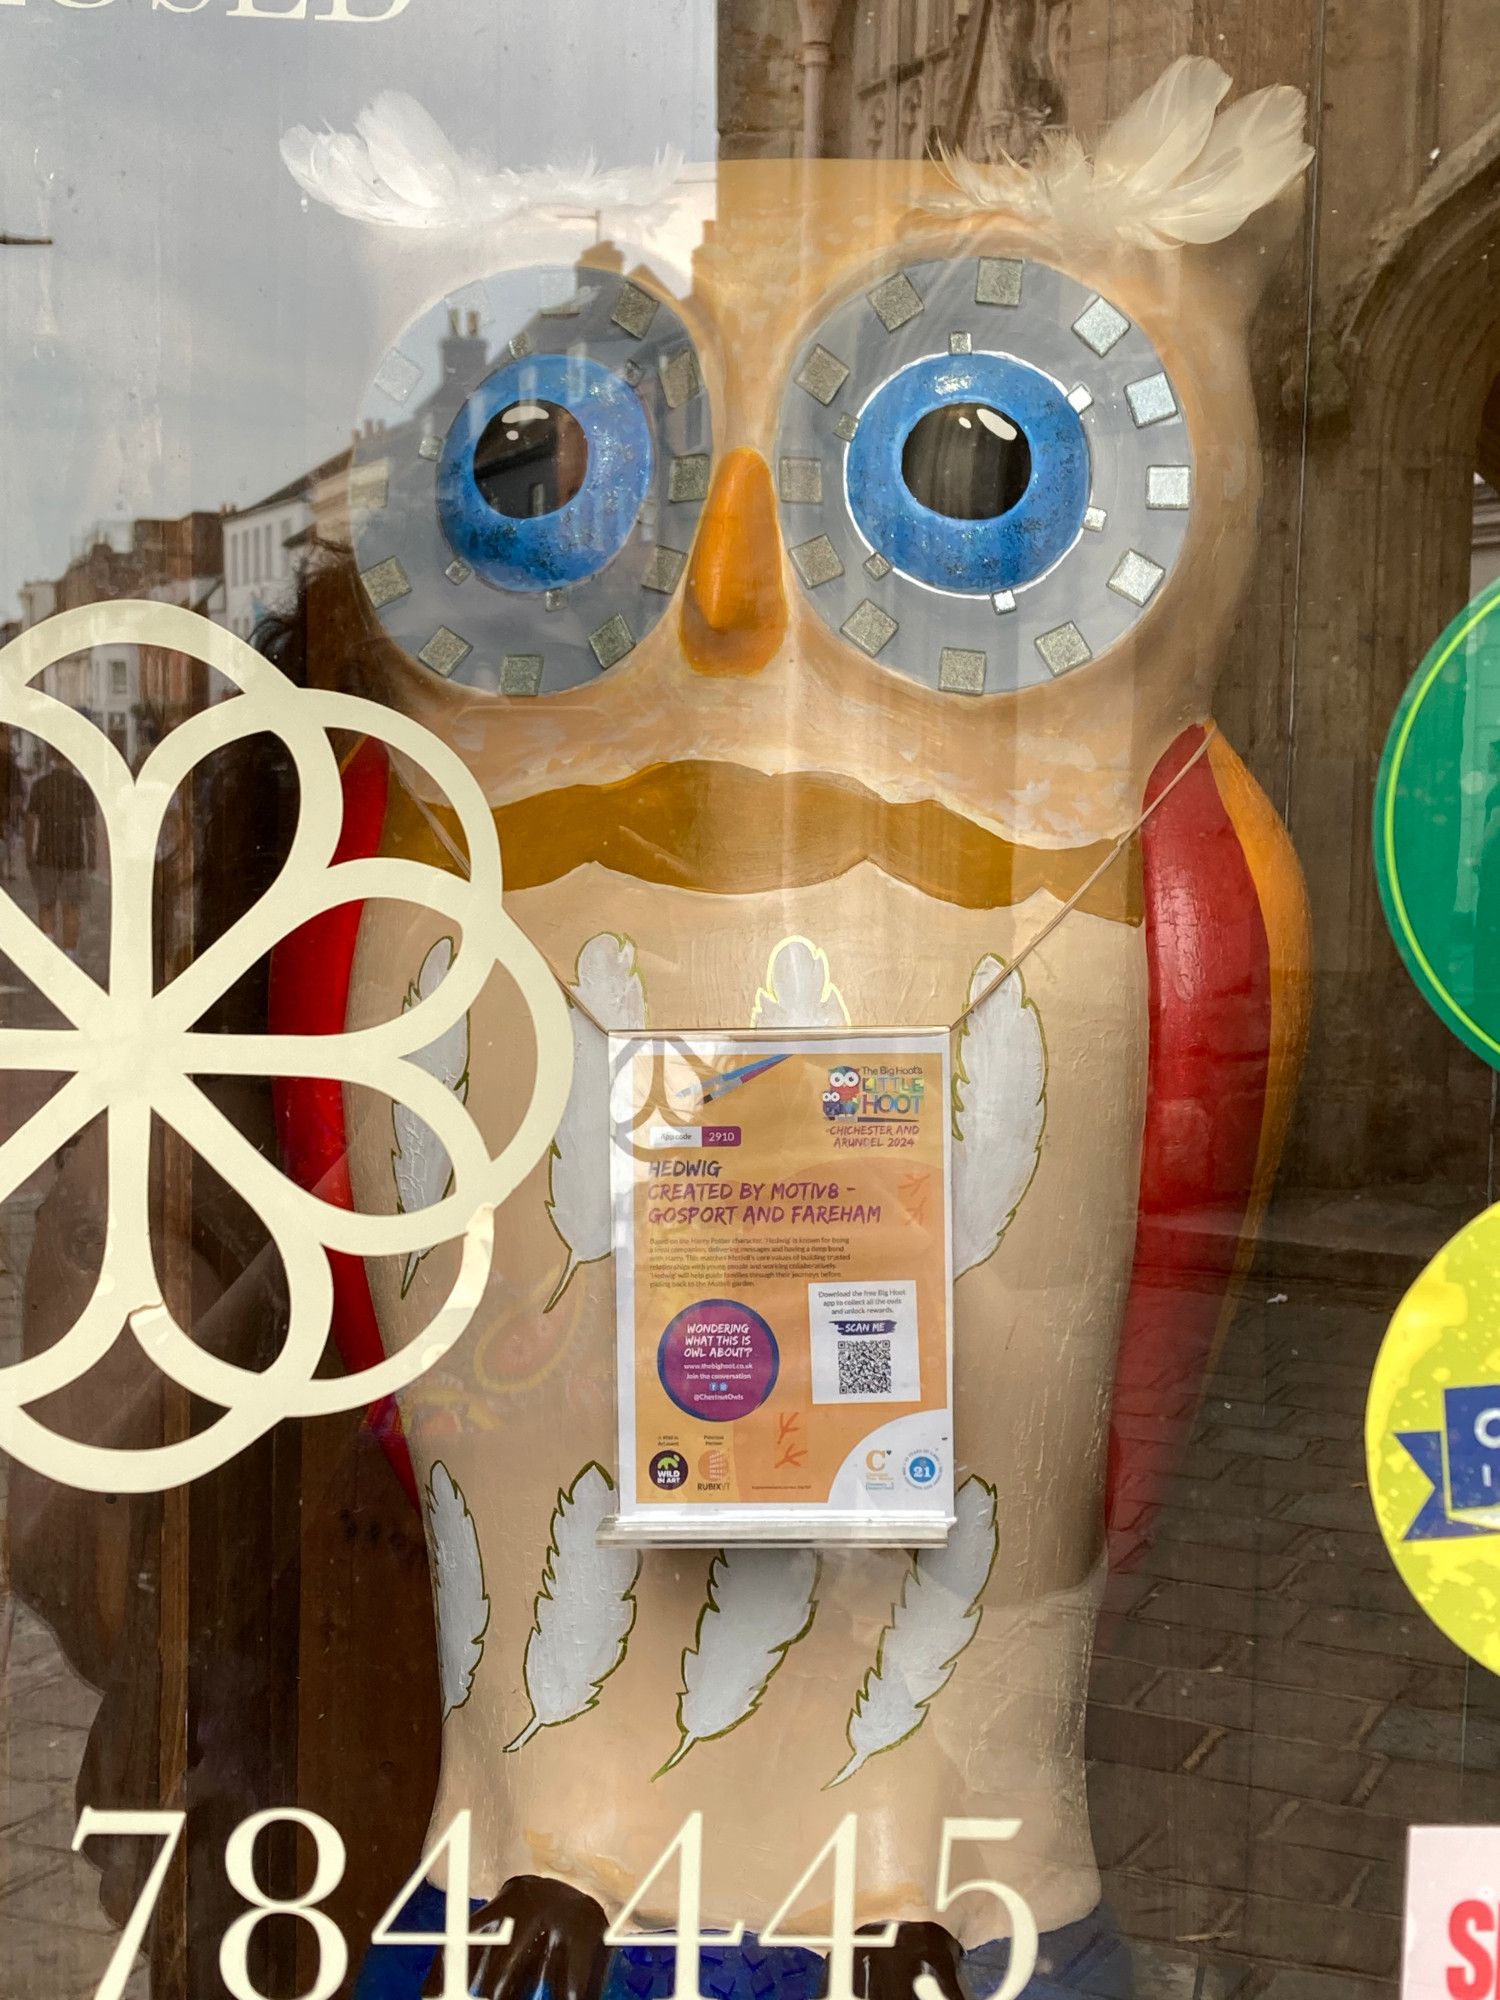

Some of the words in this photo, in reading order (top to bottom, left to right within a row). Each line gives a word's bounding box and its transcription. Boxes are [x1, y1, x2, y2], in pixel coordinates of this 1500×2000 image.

[862, 1065, 879, 1076] The
[880, 1065, 895, 1076] Big
[896, 1065, 923, 1076] Hoot's
[862, 1077, 925, 1093] LITTLE
[862, 1094, 924, 1114] HOOT
[829, 1125, 894, 1136] CHICHESTER
[896, 1125, 920, 1136] AND
[708, 1131, 736, 1142] 2910
[833, 1138, 884, 1149] ARUNDEL
[886, 1138, 916, 1149] 2024
[648, 1159, 722, 1178] HEDWIG
[648, 1182, 734, 1201] CREATED
[740, 1182, 766, 1201] BY
[771, 1182, 840, 1201] MOTIV8
[648, 1204, 739, 1225] GOSPORT
[742, 1204, 785, 1225] AND
[791, 1204, 881, 1225] FAREHAM
[818, 1290, 851, 1298] Download
[852, 1289, 863, 1297] the
[863, 1289, 877, 1297] free
[878, 1288, 888, 1297] Big
[889, 1288, 906, 1296] Hoot
[831, 1307, 844, 1315] and
[845, 1306, 866, 1314] unlock
[687, 1323, 751, 1334] WONDERING
[845, 1322, 870, 1333] SCAN
[872, 1322, 886, 1332] ME
[685, 1335, 715, 1346] WHAT
[716, 1335, 740, 1346] THIS
[741, 1335, 752, 1346] IS
[683, 1347, 707, 1358] OWL
[709, 1347, 753, 1358] ABOUT?
[686, 1372, 699, 1380] Join
[700, 1372, 711, 1380] the
[711, 1372, 752, 1380] conversation
[693, 1393, 744, 1401] @ChestnutOwls
[657, 1470, 681, 1478] WILD
[913, 1466, 931, 1478] 21
[71, 1806, 515, 2000] 784
[603, 1809, 1039, 2000] 445
